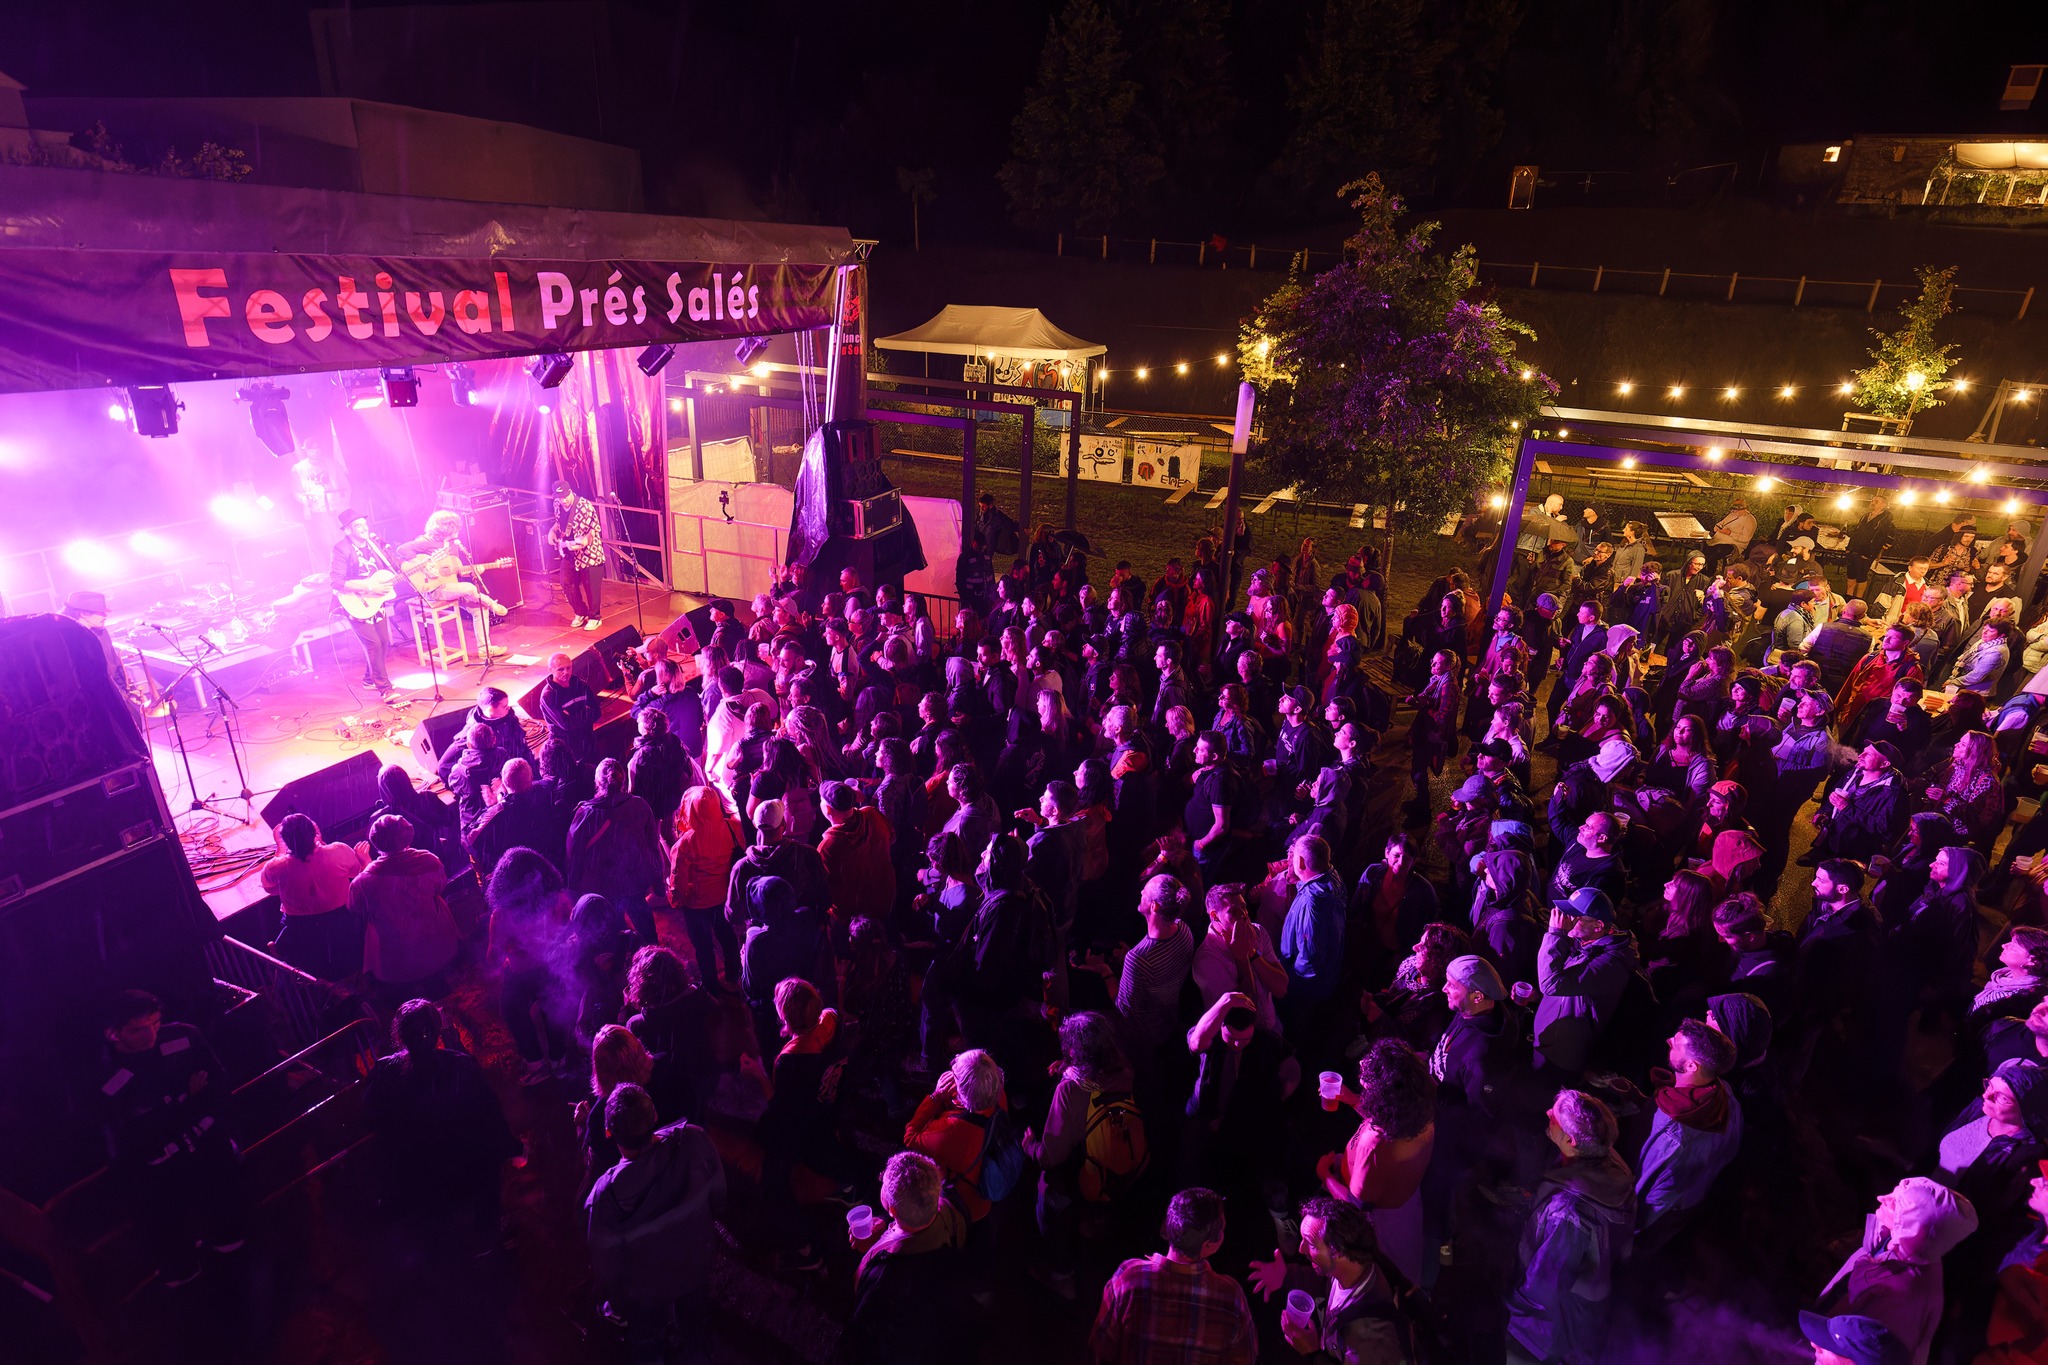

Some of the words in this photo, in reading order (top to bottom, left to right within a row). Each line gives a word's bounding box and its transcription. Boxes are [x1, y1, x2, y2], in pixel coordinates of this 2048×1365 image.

[169, 268, 515, 347] Festival
[537, 270, 647, 330] Prés
[666, 271, 759, 324] Salés
